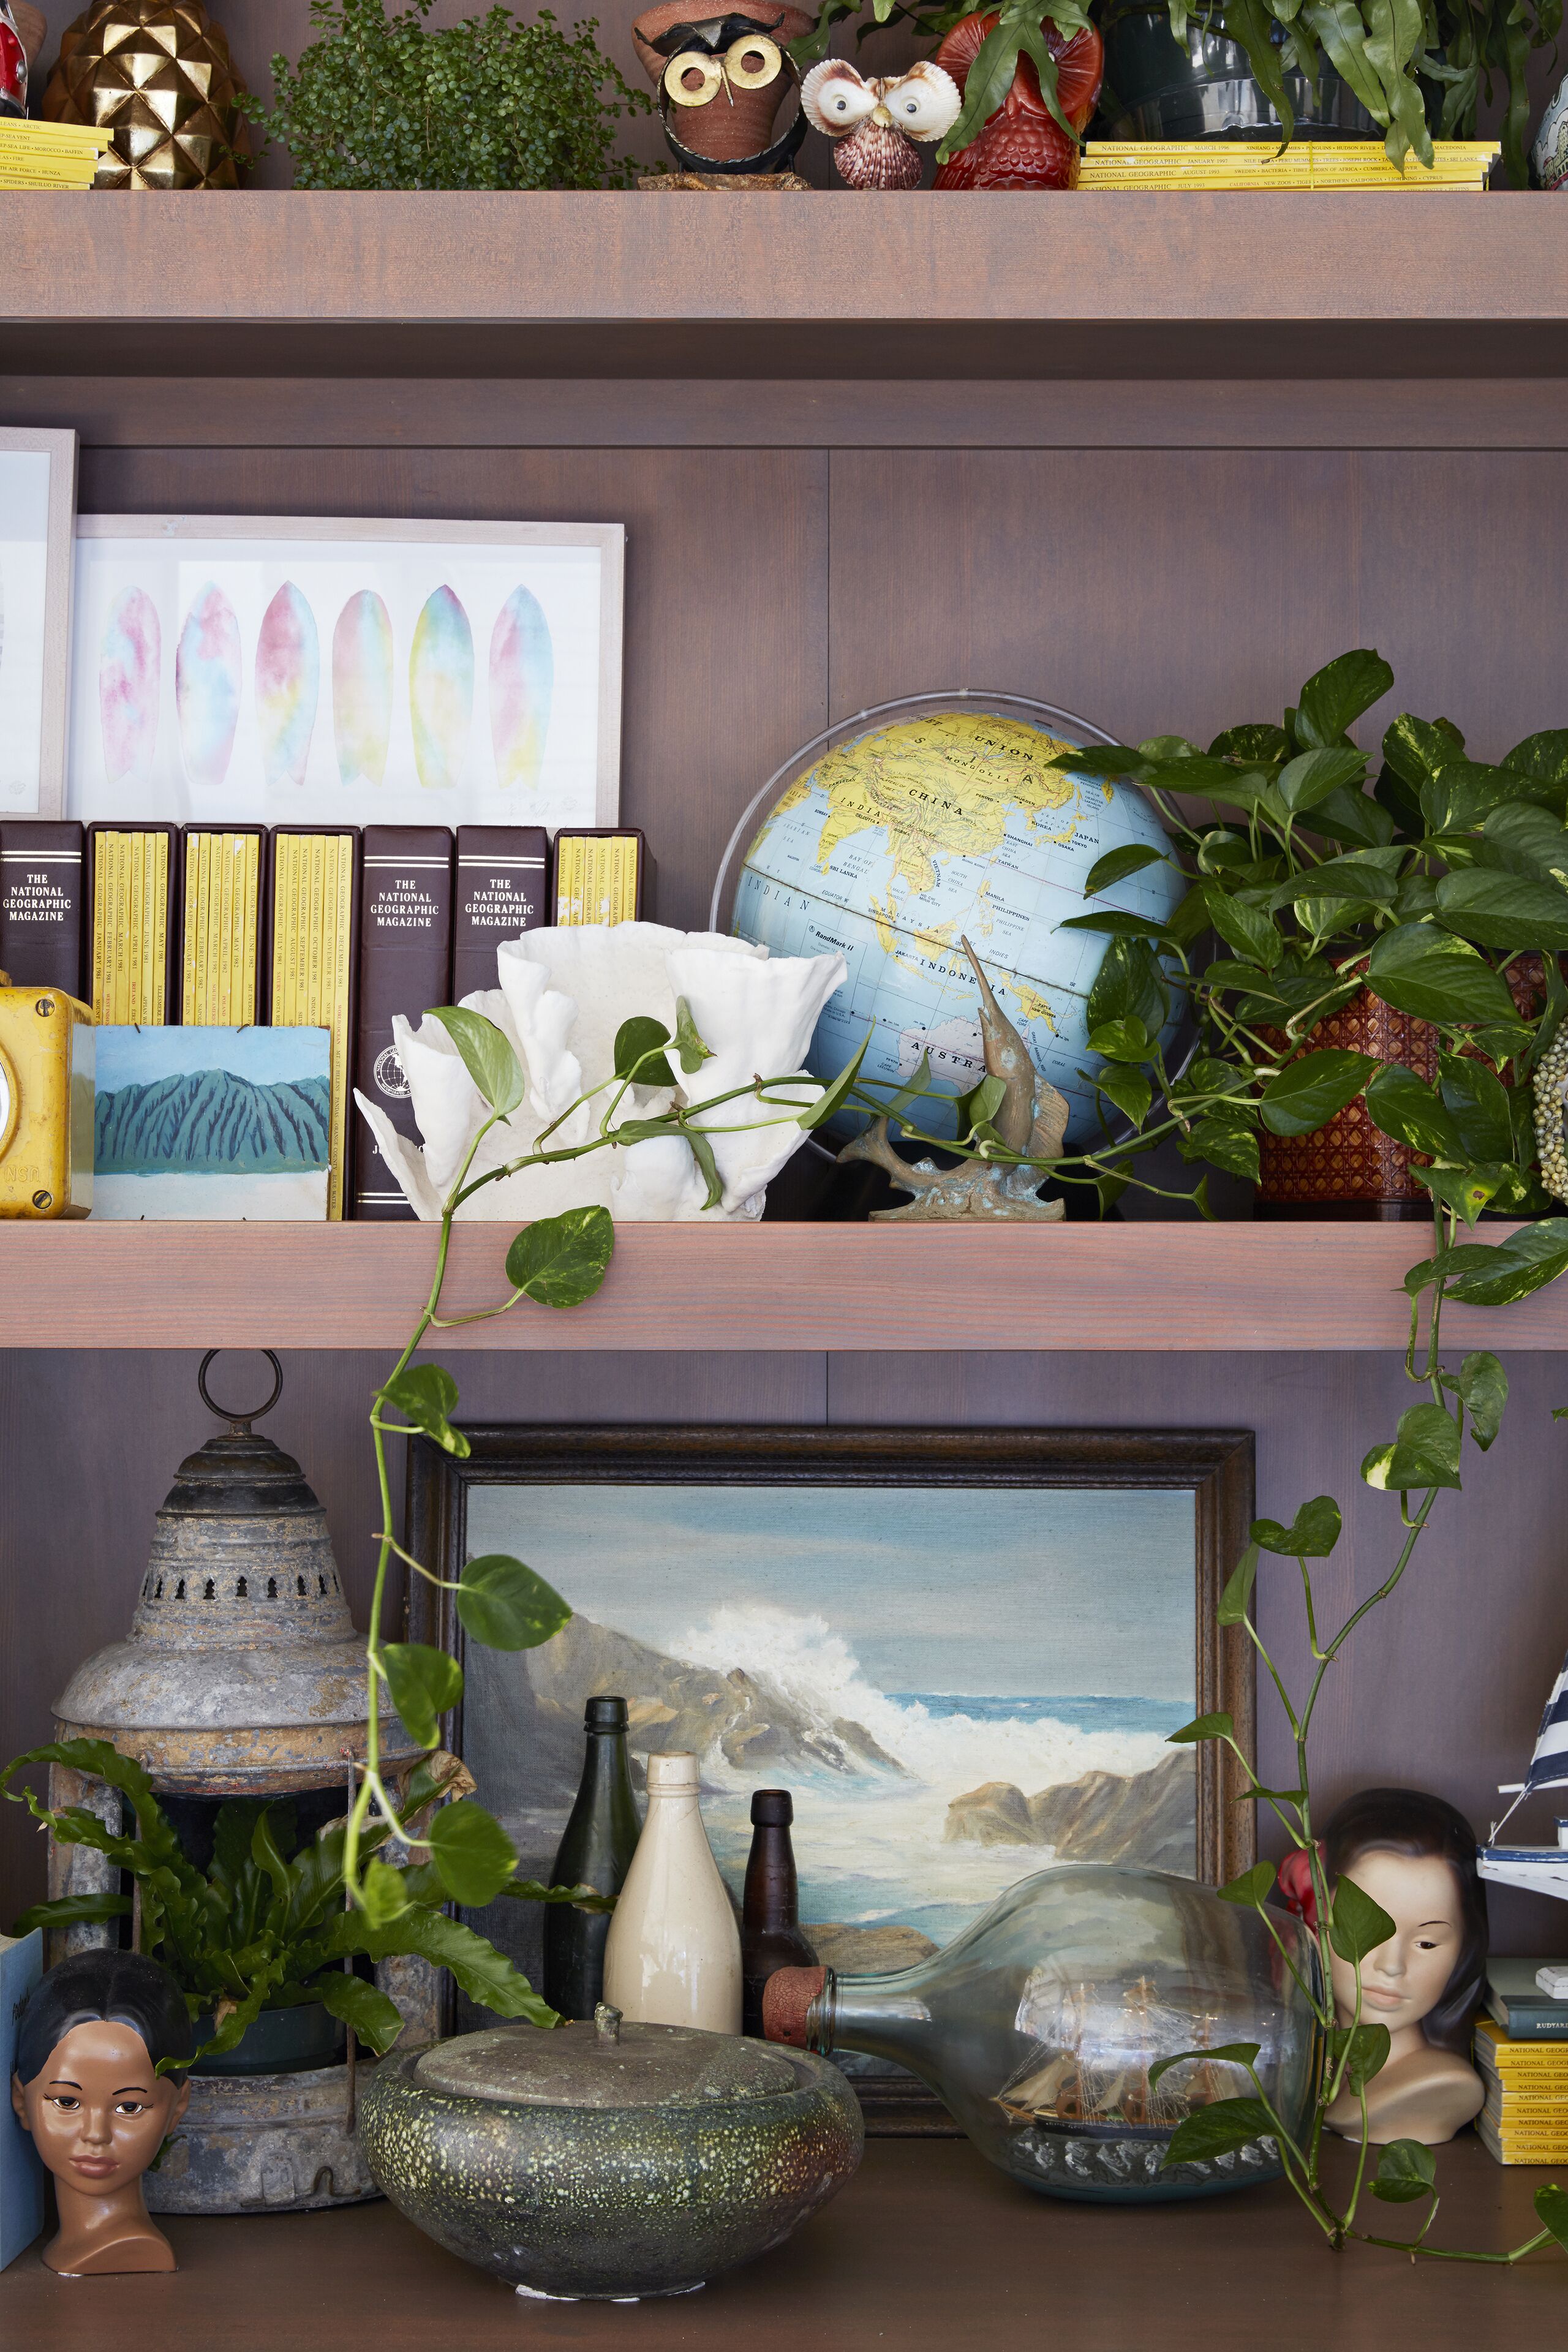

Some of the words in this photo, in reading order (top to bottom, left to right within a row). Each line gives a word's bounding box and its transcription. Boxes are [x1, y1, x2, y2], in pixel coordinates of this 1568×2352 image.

[974, 735, 1033, 761] UNION
[945, 756, 1009, 783] MONGOLIA
[909, 789, 963, 816] CHINA
[976, 793, 993, 802] PEKING
[1014, 795, 1035, 806] MUKDEN
[840, 797, 881, 817] INDIA
[814, 809, 828, 817] BOMBAY
[855, 813, 876, 824] CALCUTTA
[888, 818, 905, 827] TROPIC
[916, 827, 937, 838] CANCER
[1031, 820, 1052, 832] KOREA
[893, 827, 911, 837] BURMA
[1007, 834, 1033, 847] SHANGHAI
[1072, 840, 1087, 848] TOKYO
[1074, 832, 1099, 845] JAPAN
[1058, 843, 1074, 852] OSAKA
[848, 854, 862, 863] BAY
[843, 861, 869, 875] BENGAL
[998, 859, 1019, 870] TAIWAN
[27, 875, 48, 883] THE
[839, 869, 858, 879] LANKA
[932, 859, 941, 888] VIETNAM
[951, 870, 967, 879] SOUTH
[395, 880, 416, 889] THE
[490, 879, 511, 888] THE
[948, 877, 963, 886] CHINA
[11, 887, 64, 896] NATIONAL
[379, 892, 431, 902] NATIONAL
[473, 891, 527, 902] NATIONAL
[748, 876, 810, 911] INDIAN
[822, 889, 843, 901] EQUATOR
[985, 891, 1005, 902] MANILA
[2, 899, 71, 908] GEOGRAPHIC
[465, 903, 533, 914] GEOGRAPHIC
[371, 905, 439, 914] GEOGRAPHIC
[868, 908, 894, 921] SINGAPORE
[992, 904, 1030, 921] PHILIPPINES
[9, 911, 64, 921] MAGAZINE
[472, 916, 526, 926] MAGAZINE
[881, 907, 938, 933] MALAYSIA
[377, 917, 431, 927] MAGAZINE
[996, 918, 1025, 932] PHILIPPINE
[815, 931, 846, 949] RandMark
[895, 950, 918, 961] JAKARTA
[989, 949, 1009, 959] INDIES
[920, 959, 1006, 995] INDONEIA
[376, 1052, 389, 1071] NATIONAL
